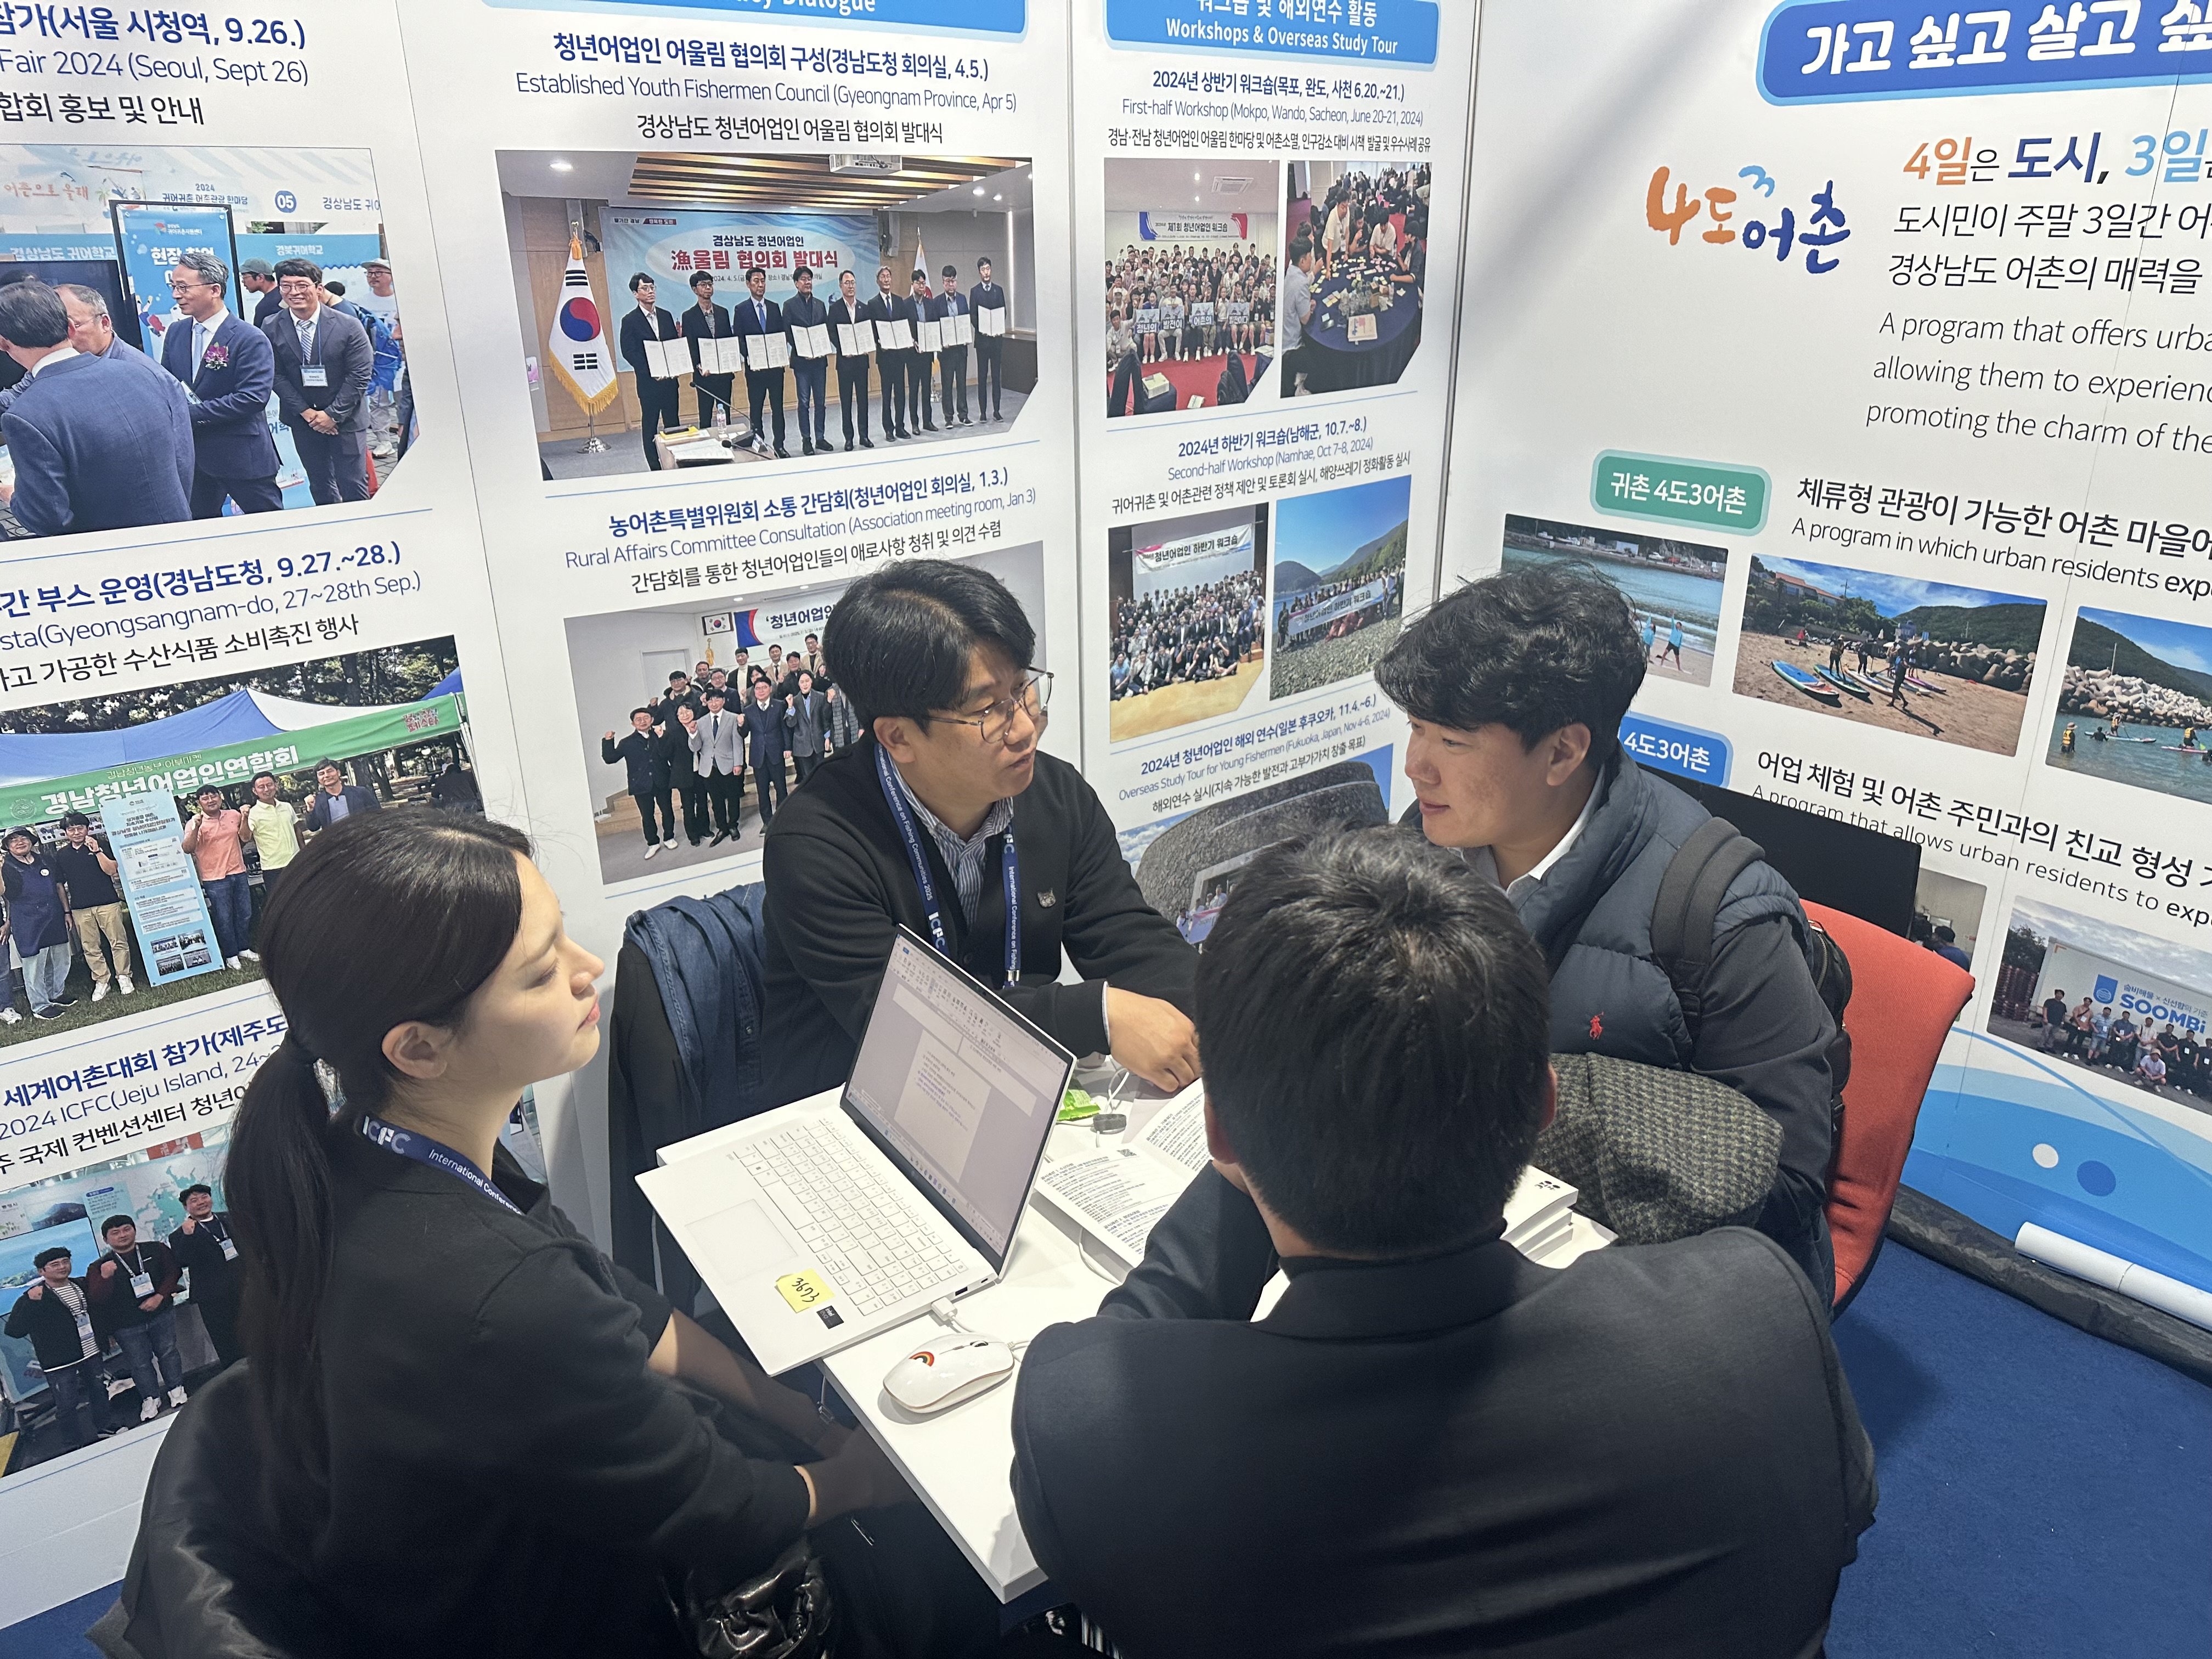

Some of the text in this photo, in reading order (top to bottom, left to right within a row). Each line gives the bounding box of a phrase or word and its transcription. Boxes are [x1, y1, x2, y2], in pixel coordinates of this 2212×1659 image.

[126, 9, 304, 49] 시청역, 9.26.)
[1166, 18, 1397, 55] Workshops & Overseas Study Tour
[1801, 1, 2142, 75] 가고 싶고 살고
[0, 49, 307, 86] Fair 2024 (Seoul, Sept 26)
[553, 32, 988, 81] 청년어업인 어울림 협의회 구성(경남도청 회의실, 4.5.)
[516, 72, 1015, 113] Established Youth Fishermen Council (Gyeongnam Province, Apr 5)
[1153, 70, 1404, 102] 2024년 상반기 워크숍(목포, 완도, 사천 6.20.~21.)
[1122, 98, 1423, 126] First-half Workshop (Mokpo, Wando, Sacheon, June 20-21, 2024)
[1903, 132, 2109, 185] 4일은 도시,
[195, 183, 215, 192] 2024
[277, 196, 294, 209] 05
[323, 197, 361, 211] 경상남도
[671, 250, 839, 270] 漁울림 협의회 발대식
[713, 235, 804, 247] 경상남도 청년어업인
[1880, 313, 2147, 348] A program that offers
[1874, 357, 2079, 392] allowing them to
[1178, 416, 1366, 456] 2024년 하반기 워크숍(남해군, 10.7.~8.)
[1866, 400, 1989, 438] promoting
[1997, 410, 2036, 436] the
[2044, 415, 2127, 445] charm
[2137, 424, 2168, 448] of
[1168, 436, 1373, 480] Second-half Workshop (Namhae, Oct 7-8, 2024)
[608, 466, 1007, 537] 농어촌특별위원회 소통 간담회(청년어업인 회의실, 1.3.)
[1611, 472, 1746, 515] 귀촌 4도3어촌
[566, 487, 1035, 568] Rural Affairs Committee Consultation (Association meeting room, Jan 3)
[1791, 517, 2159, 588] A program in which urban residents
[37, 540, 400, 614] 부스 운영(경남도청, 9.27.~28.)
[283, 579, 370, 608] 27~28th
[374, 570, 420, 595] Sep.)
[1141, 693, 1376, 775] 2024년 청년어업인 해외 연수(일본 후쿠오카, 11.4.~6.)
[1624, 732, 1711, 774] 4도3어촌
[886, 776, 933, 901] Conference on Fishing Communities 2025
[1960, 843, 2158, 910] urban residents to
[928, 912, 946, 949] ICFC
[3, 1049, 157, 1106] 세계어촌대회
[0, 1062, 227, 1139] 2024 ICFC(Jeju Island,
[362, 1115, 483, 1188] ICFC International
